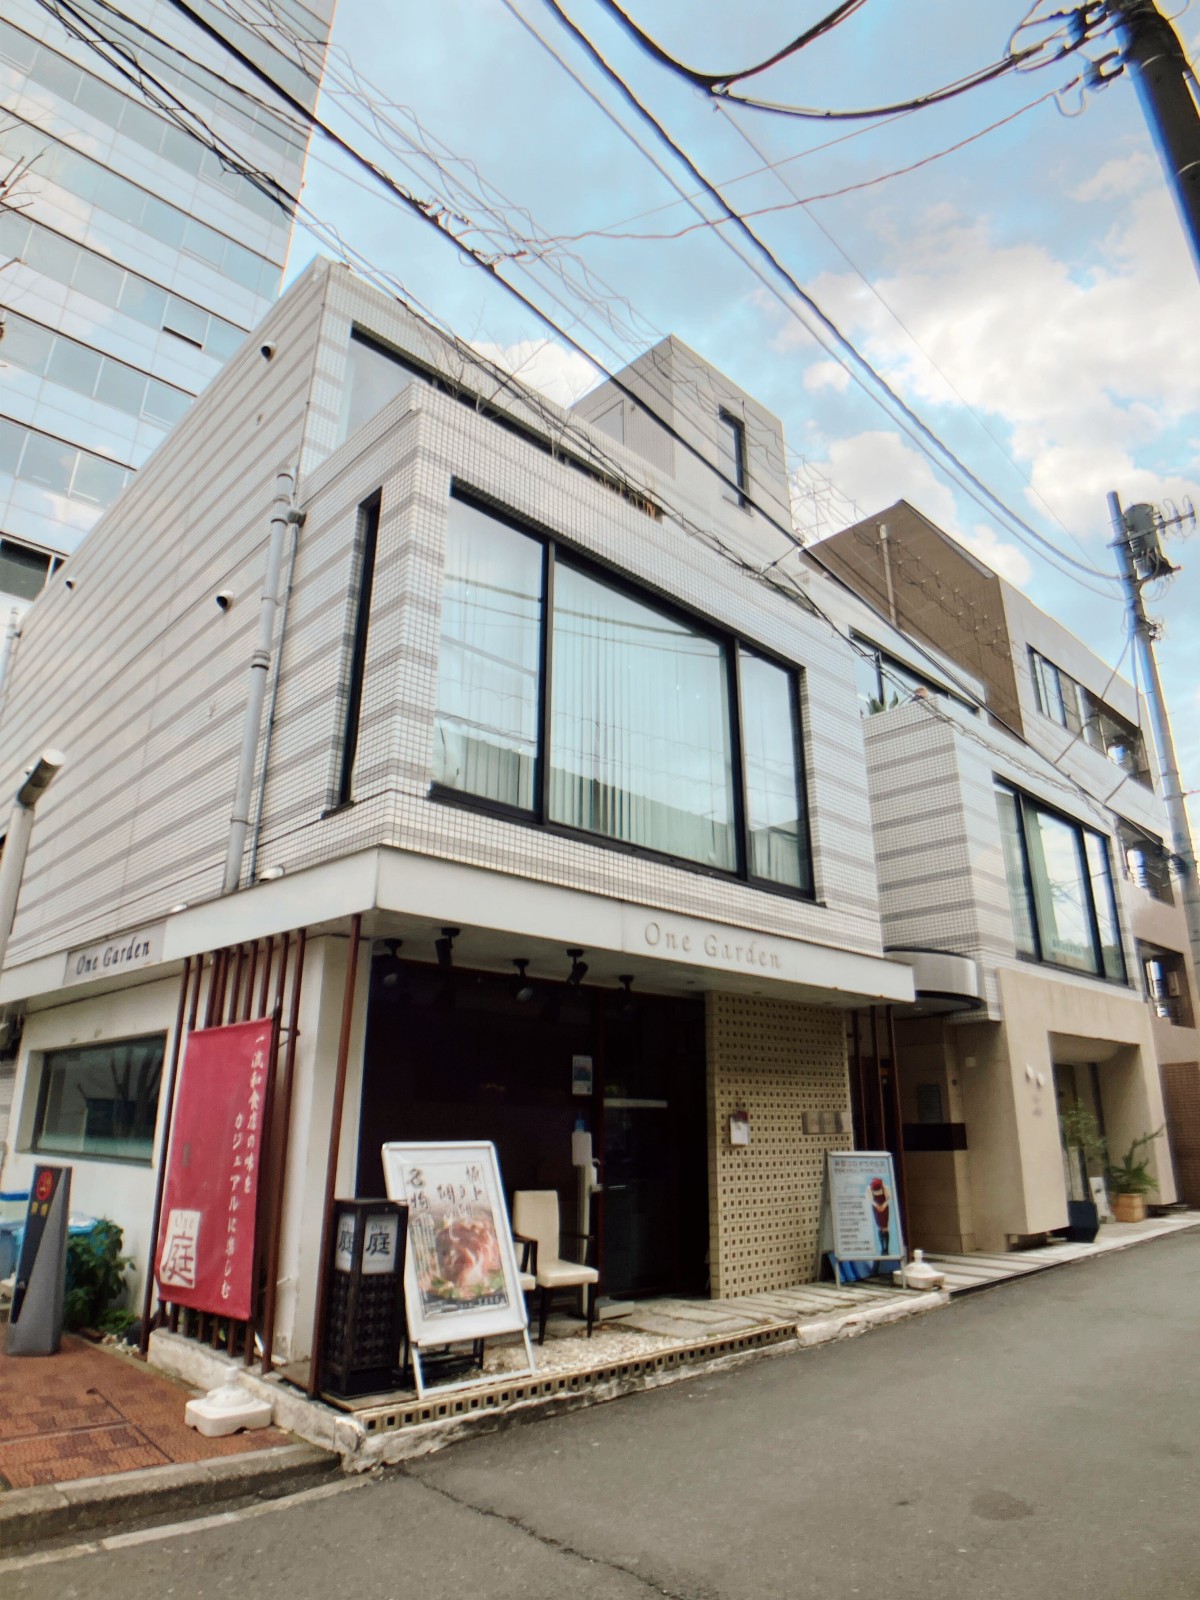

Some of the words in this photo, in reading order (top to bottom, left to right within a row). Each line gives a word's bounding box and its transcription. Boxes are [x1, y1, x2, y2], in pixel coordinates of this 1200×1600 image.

[76, 954, 98, 975] One
[103, 936, 150, 967] Garden
[644, 921, 693, 953] One
[703, 933, 783, 970] Garden
[246, 1035, 265, 1194] 一流和食店の味を
[161, 1230, 194, 1286] 庭
[365, 1231, 391, 1256] 庭
